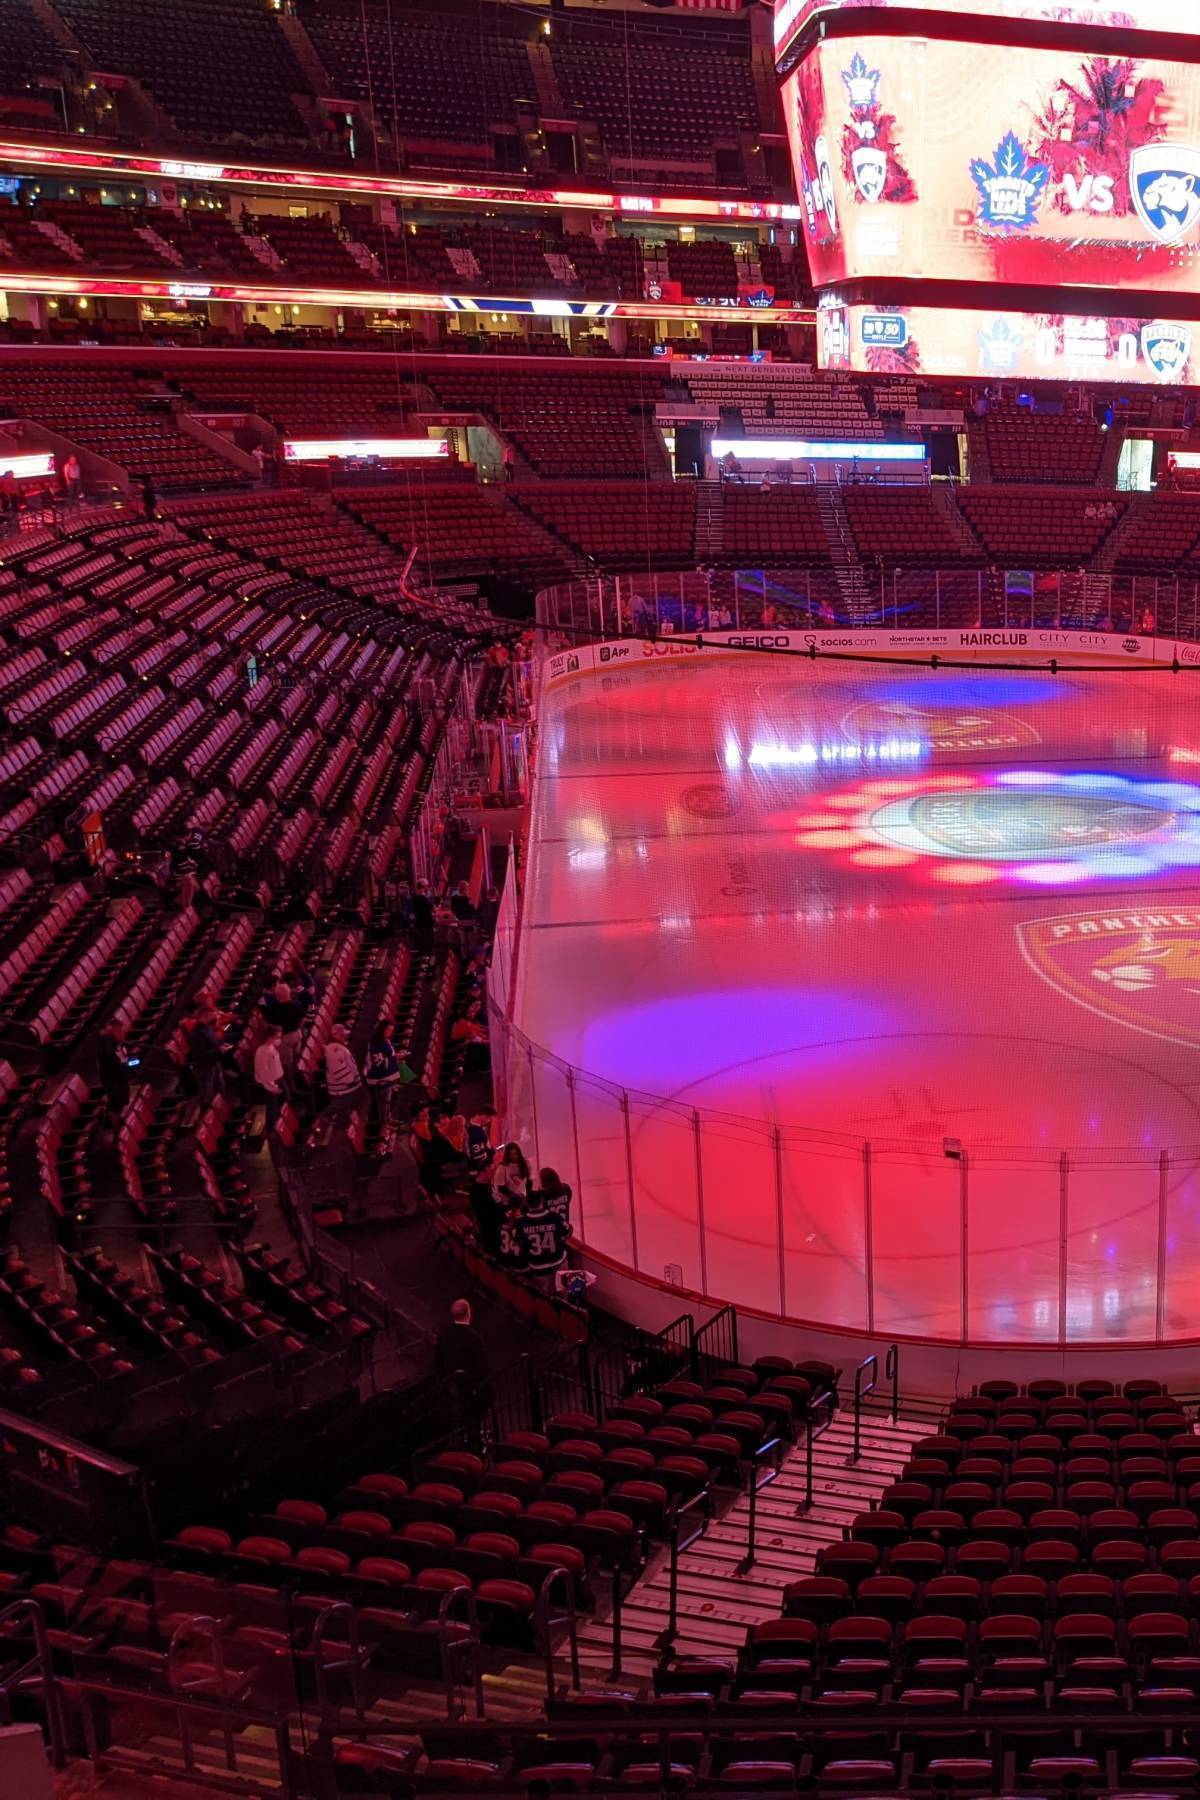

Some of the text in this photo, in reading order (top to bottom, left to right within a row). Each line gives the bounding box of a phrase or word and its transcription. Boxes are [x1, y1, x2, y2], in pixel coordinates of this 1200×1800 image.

[1063, 174, 1116, 212] VS
[751, 366, 808, 375] GENERATION
[728, 636, 790, 648] GEICO
[960, 633, 1028, 646] HAIRCLUB
[1039, 633, 1069, 643] CITY
[1079, 635, 1108, 645] CITY
[522, 1224, 557, 1234] MATTHEWS
[527, 1231, 557, 1256] 34
